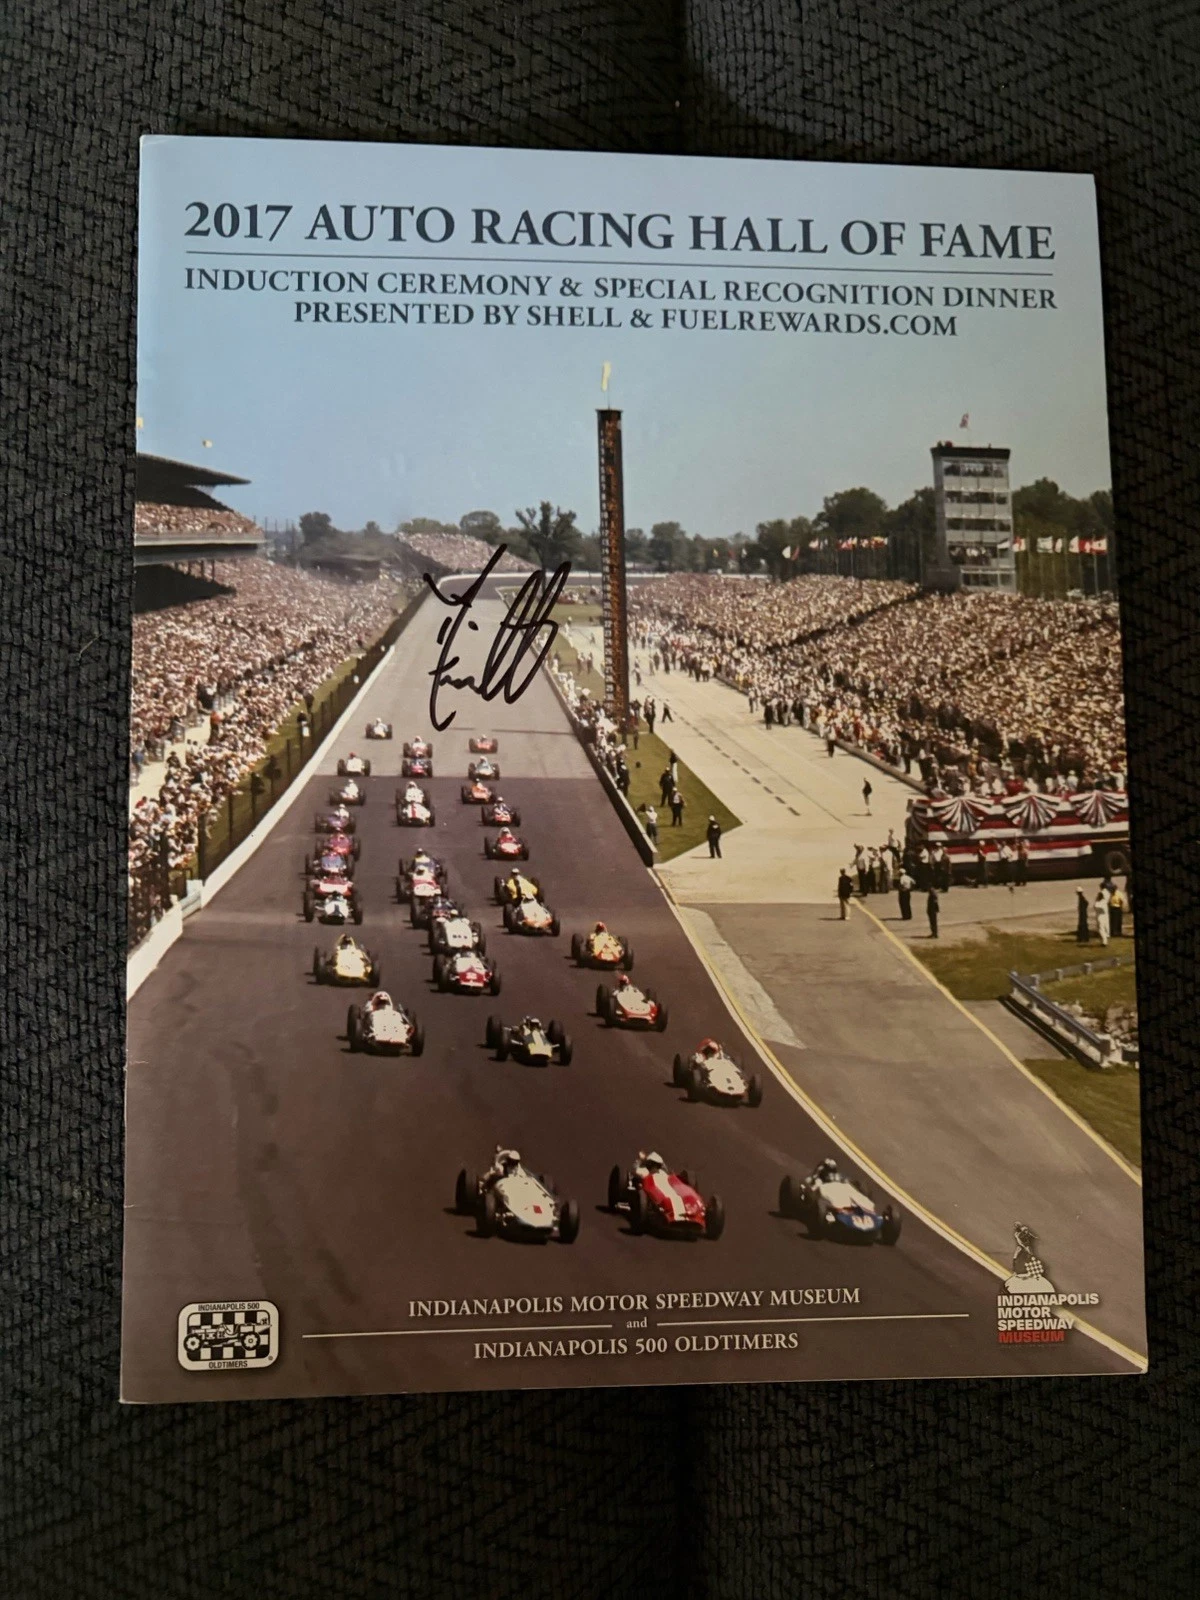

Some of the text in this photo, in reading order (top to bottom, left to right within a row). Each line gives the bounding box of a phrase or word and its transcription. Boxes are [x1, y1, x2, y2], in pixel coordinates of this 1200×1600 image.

[185, 202, 1055, 259] 2017 AUTO RACING HALL OF FAME
[186, 268, 1057, 308] INDUCTION CEREMONY & SPECIAL RECOGNITION DINNER
[295, 302, 956, 336] PRESENTED BY SHELL & FUELREWARDS.COM
[409, 1288, 859, 1316] INDIANAPOLIS MOTOR SPEEDWAY MUSEUM
[997, 1293, 1099, 1306] INDIANAPOLIS
[198, 1303, 246, 1311] INDIANAPOLIS
[997, 1306, 1051, 1319] MOTOR
[627, 1317, 647, 1328] and
[997, 1319, 1075, 1331] SPEEDWAY
[998, 1331, 1065, 1343] MUSEUM
[475, 1333, 798, 1358] INDIANAPOLIS 500 OLDTIMERS
[208, 1360, 248, 1369] OLDTIMERS
